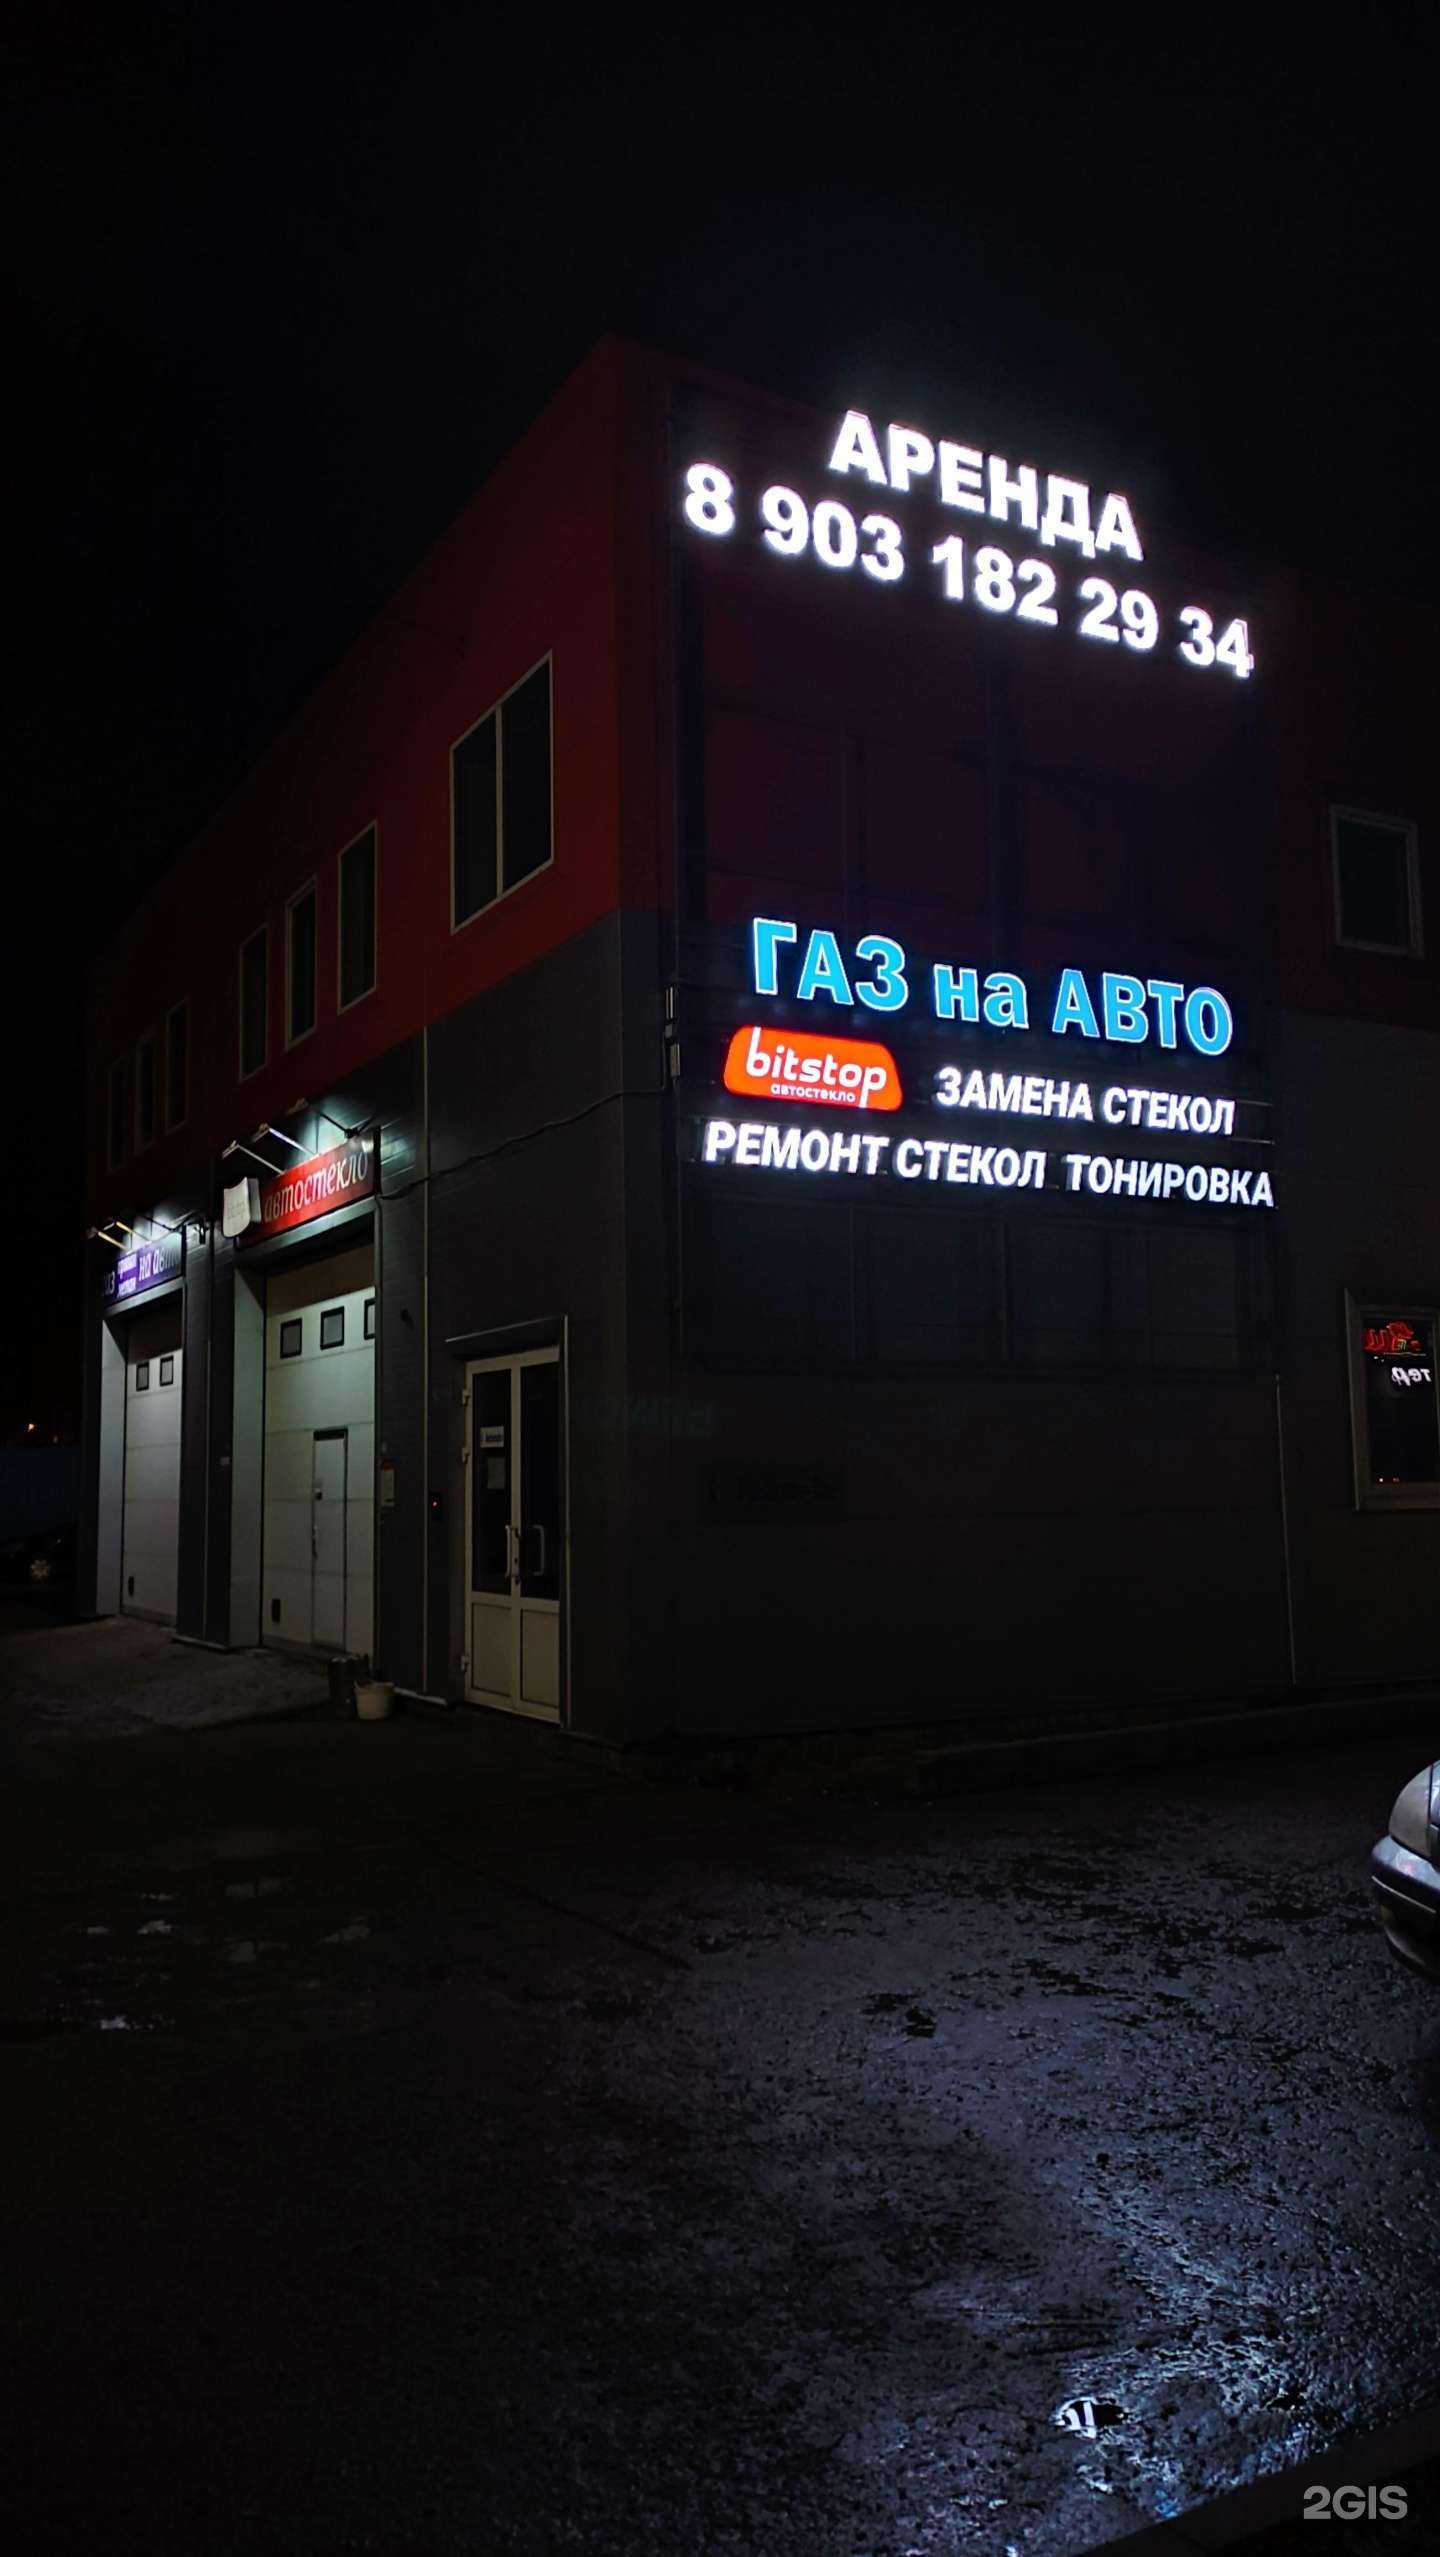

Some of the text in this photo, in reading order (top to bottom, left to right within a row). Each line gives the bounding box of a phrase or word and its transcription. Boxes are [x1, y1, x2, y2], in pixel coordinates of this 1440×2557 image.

[828, 410, 1144, 562] АРЕНДА
[684, 463, 1254, 678] 8 903 182 29 34
[752, 917, 1233, 1055] ГАЗ на АВТО
[746, 1026, 887, 1109] bitstop
[770, 1083, 856, 1103] автостекло
[936, 1067, 1236, 1136] ЗАМЕНА СТЕКОЛ
[263, 1152, 368, 1223] автостекло
[704, 1121, 1275, 1208] РЕМОНТ СТЕКОЛ ТОНИРОВКА
